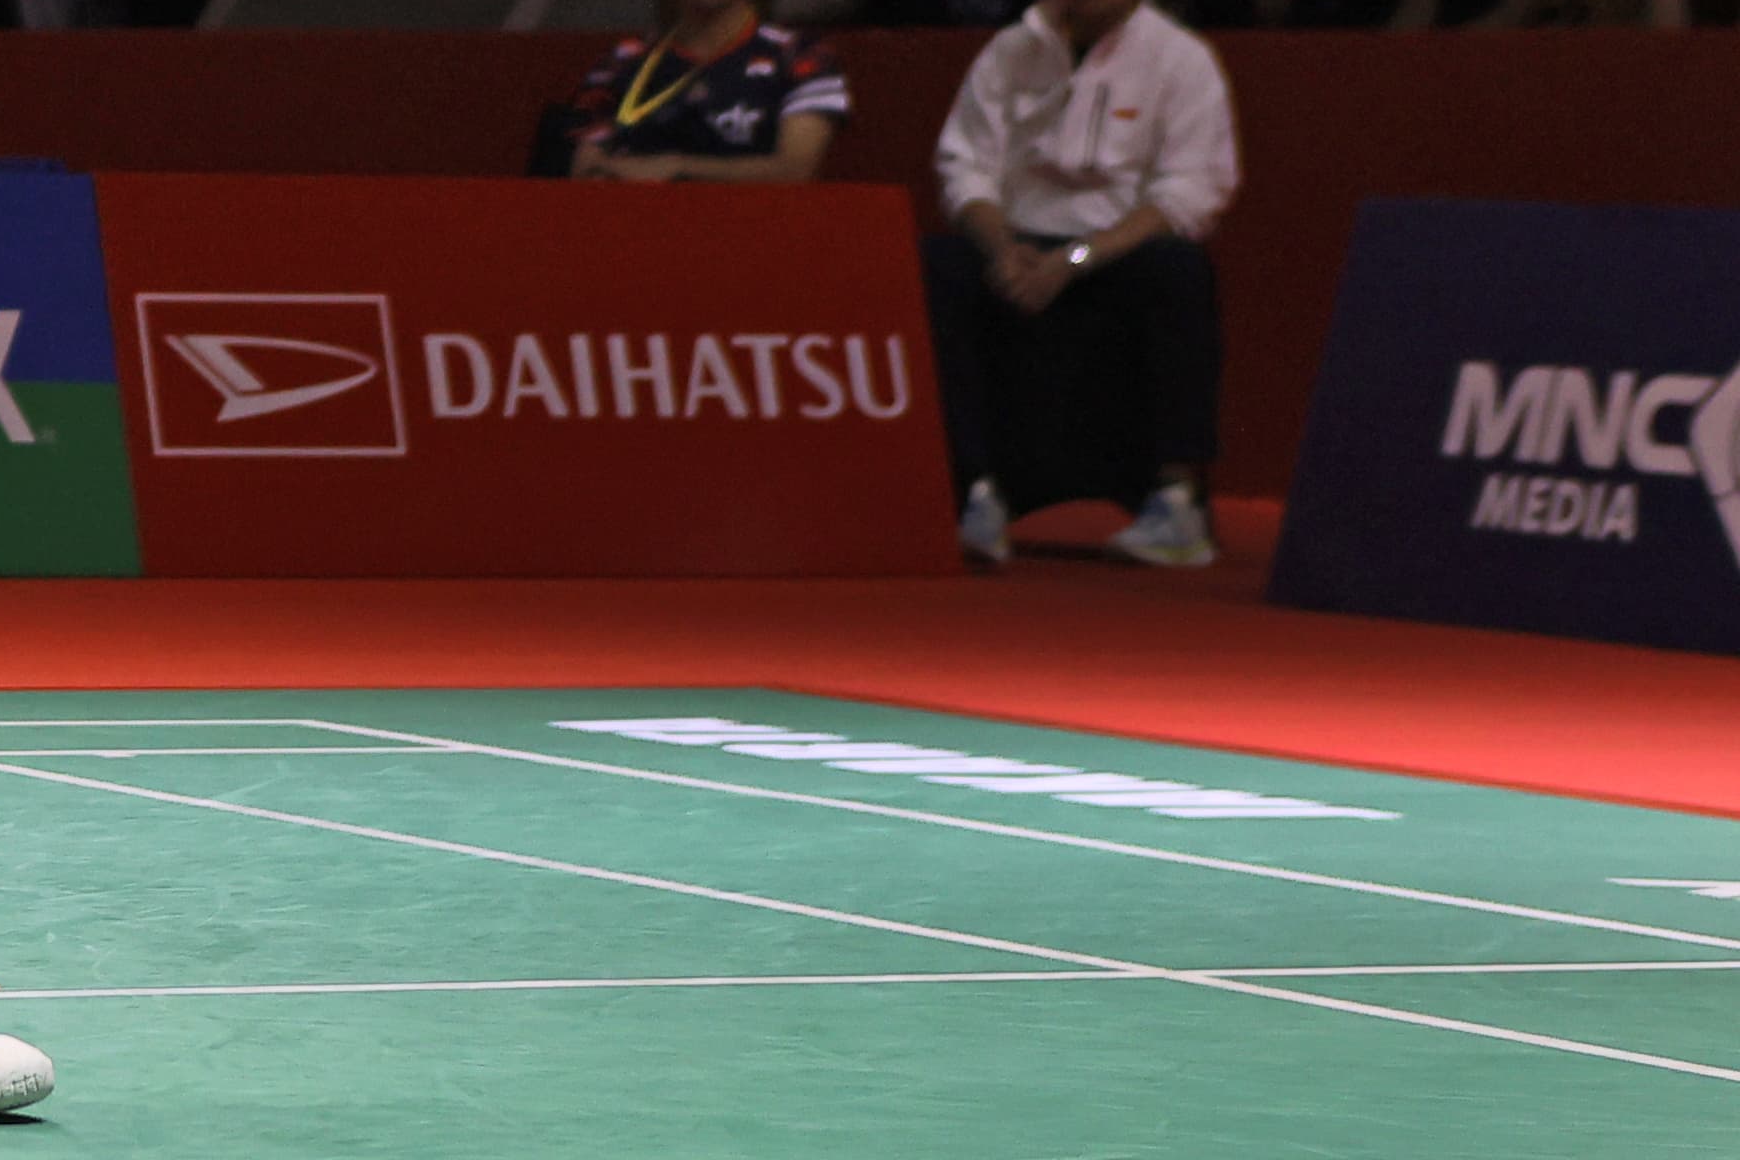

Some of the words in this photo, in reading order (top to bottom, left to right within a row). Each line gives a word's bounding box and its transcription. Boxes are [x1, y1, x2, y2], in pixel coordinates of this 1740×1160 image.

[421, 332, 912, 422] DAIHATSU
[1440, 360, 1720, 478] MNC
[1469, 473, 1642, 541] MEDIA
